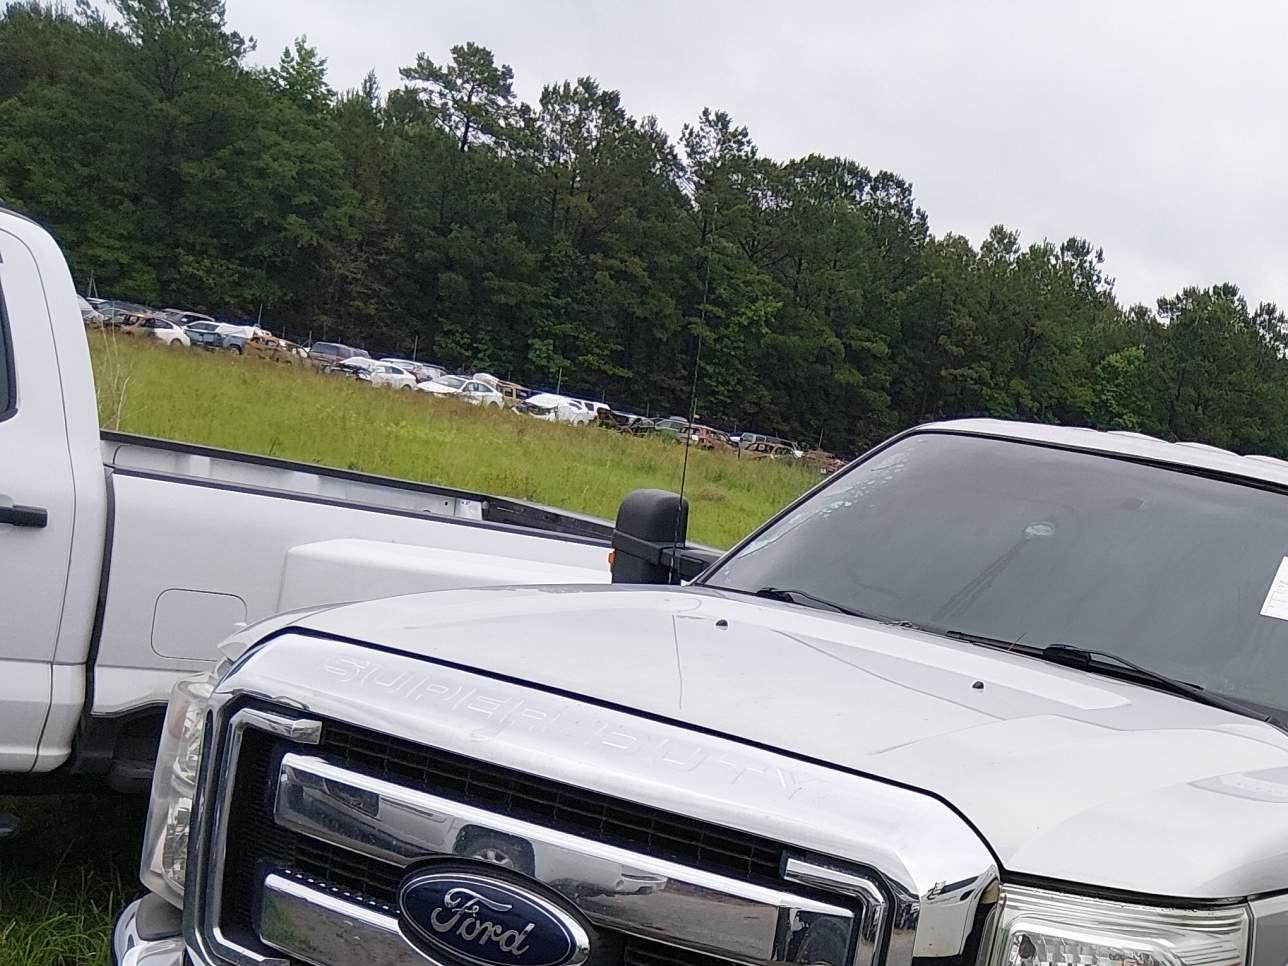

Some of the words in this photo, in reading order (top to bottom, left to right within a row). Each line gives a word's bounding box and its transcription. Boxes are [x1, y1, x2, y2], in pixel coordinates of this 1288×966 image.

[320, 654, 562, 739] SUPER
[585, 716, 820, 800] DUTY
[430, 887, 536, 956] Ford
